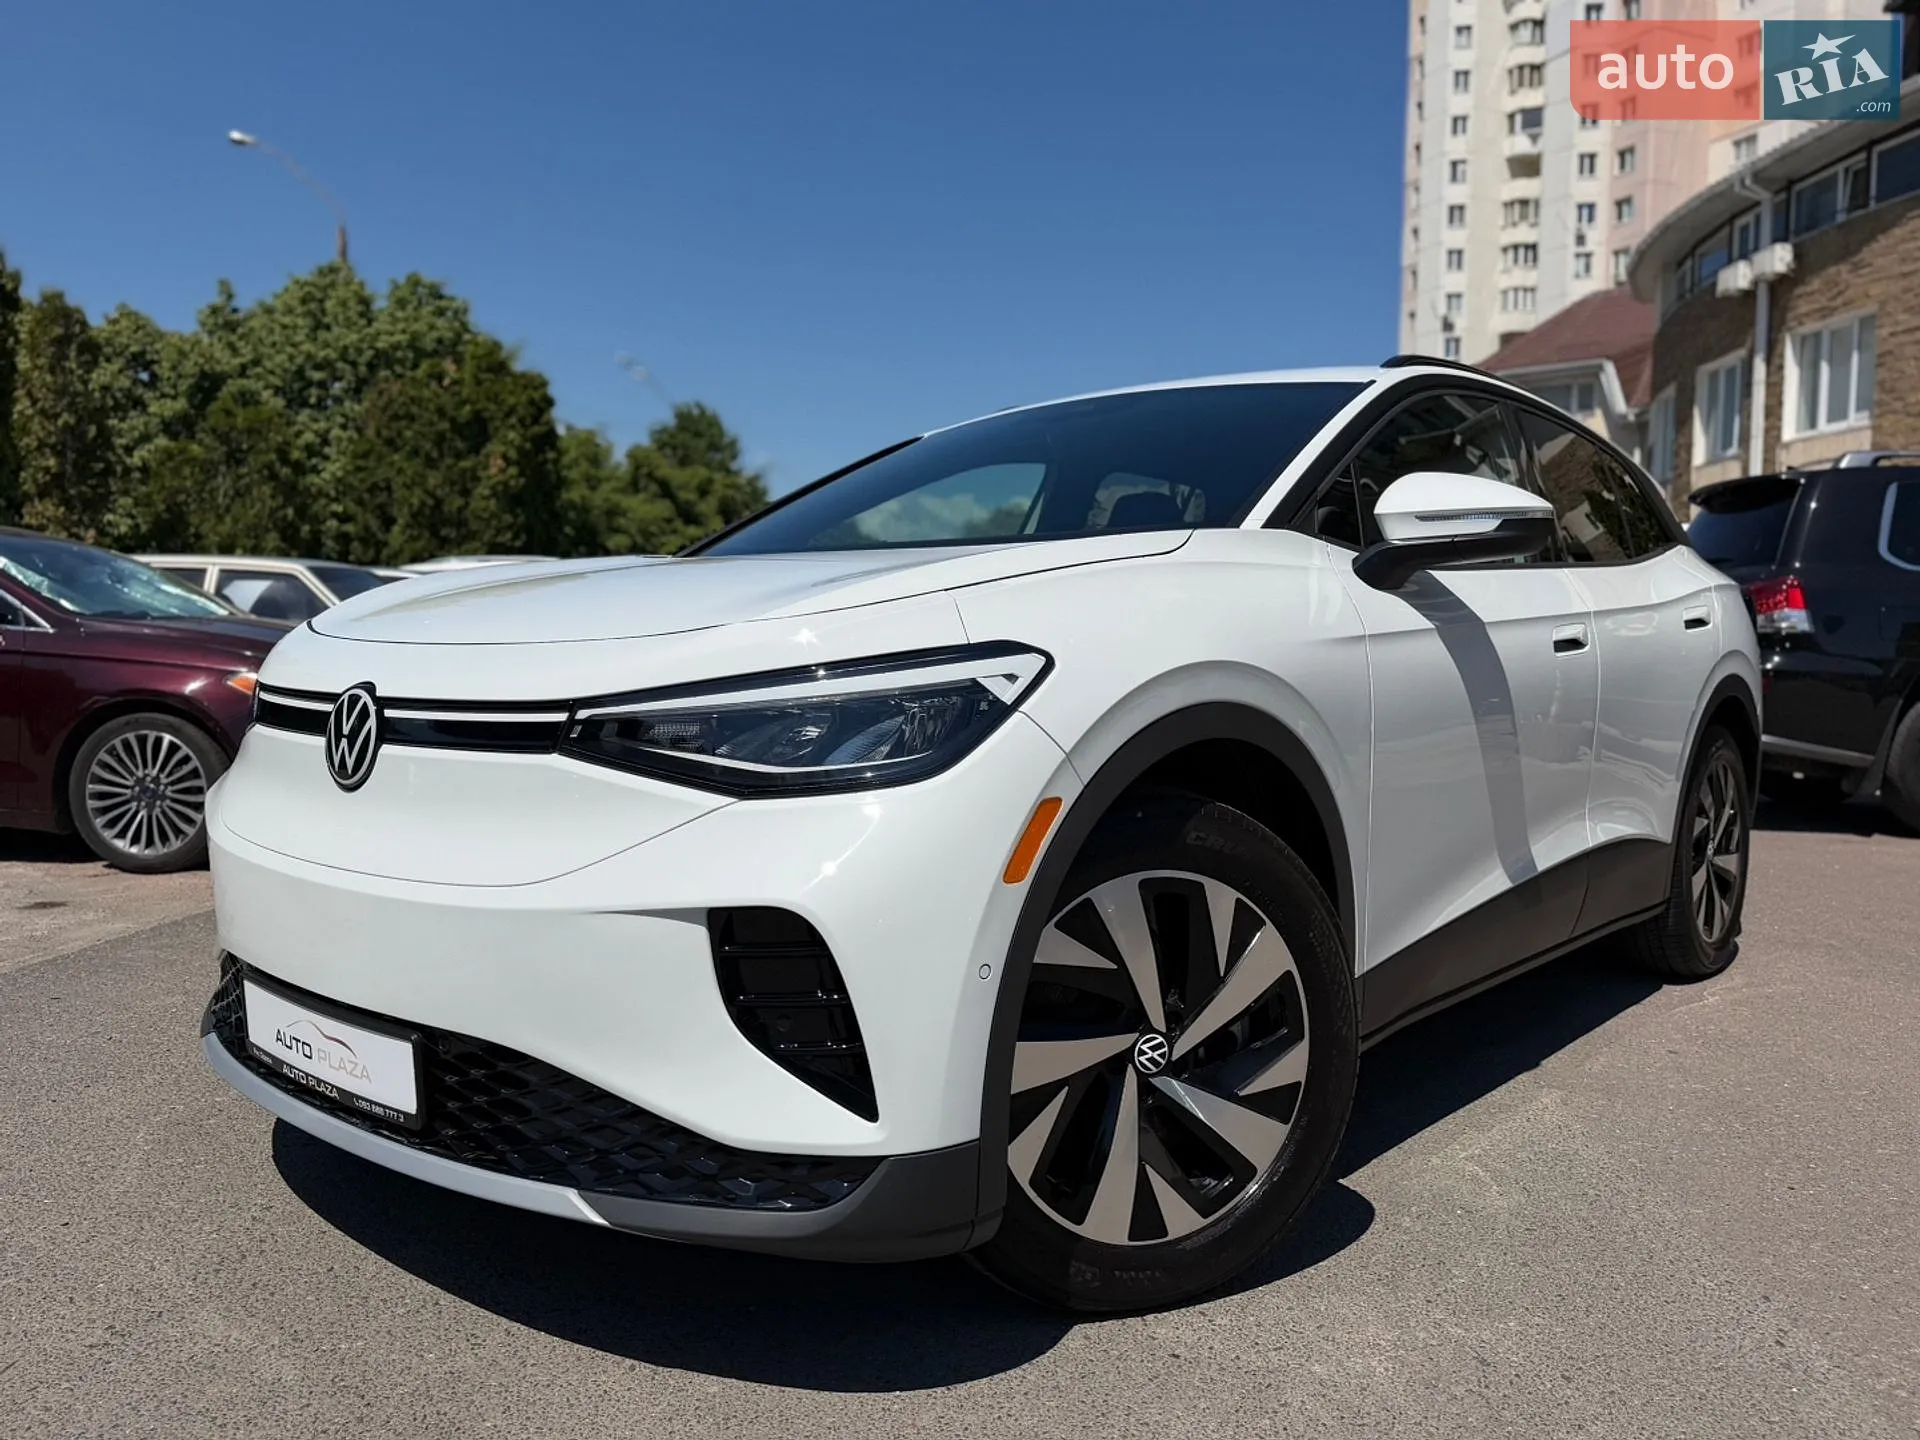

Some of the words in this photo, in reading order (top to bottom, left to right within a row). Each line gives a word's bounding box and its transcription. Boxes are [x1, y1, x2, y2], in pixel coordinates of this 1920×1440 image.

[330, 689, 376, 782] VW
[276, 1028, 313, 1060] AUTO
[317, 1048, 372, 1084] PLAZA
[282, 1064, 307, 1084] AUTO
[308, 1076, 340, 1100] PLAZA
